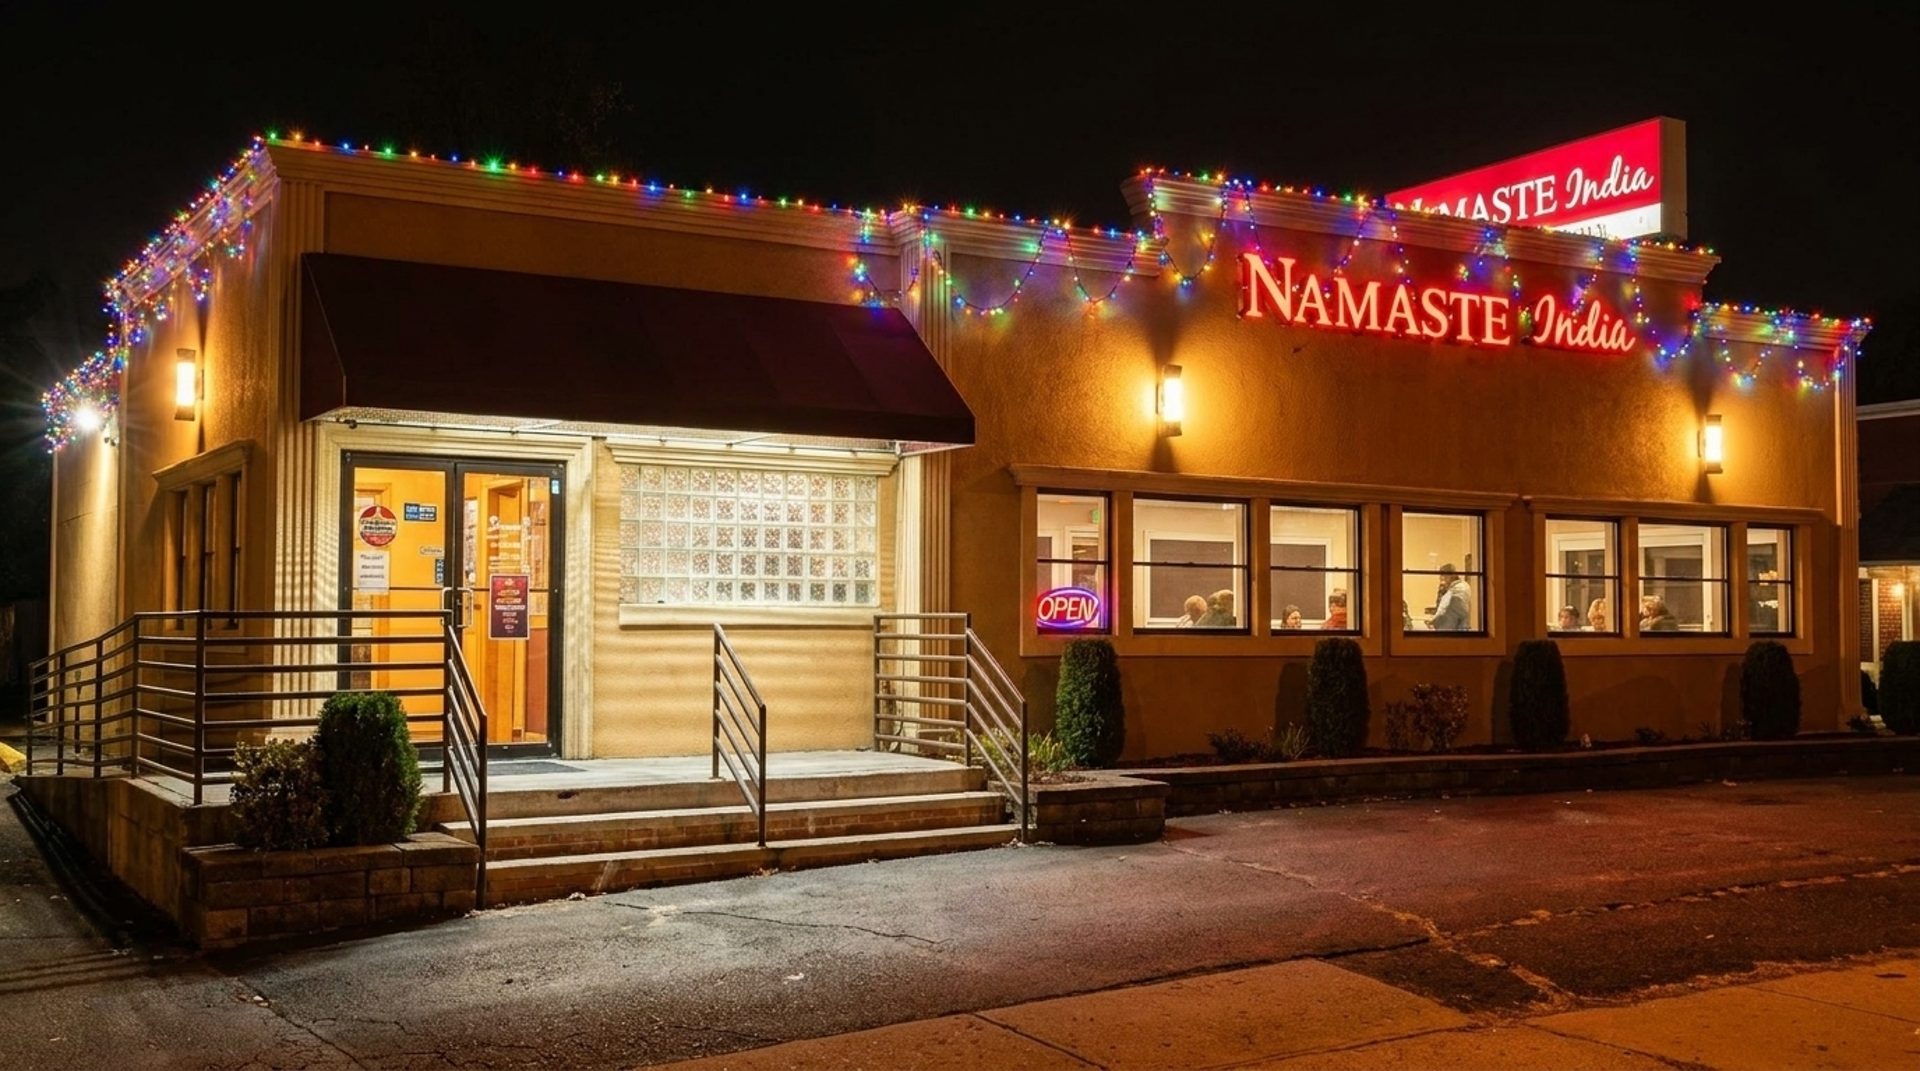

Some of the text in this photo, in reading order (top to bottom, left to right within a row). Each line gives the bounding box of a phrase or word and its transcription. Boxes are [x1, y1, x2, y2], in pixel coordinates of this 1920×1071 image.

[1565, 155, 1654, 209] India
[1245, 253, 1636, 353] NAMASTE India
[1038, 597, 1095, 622] OPEN
